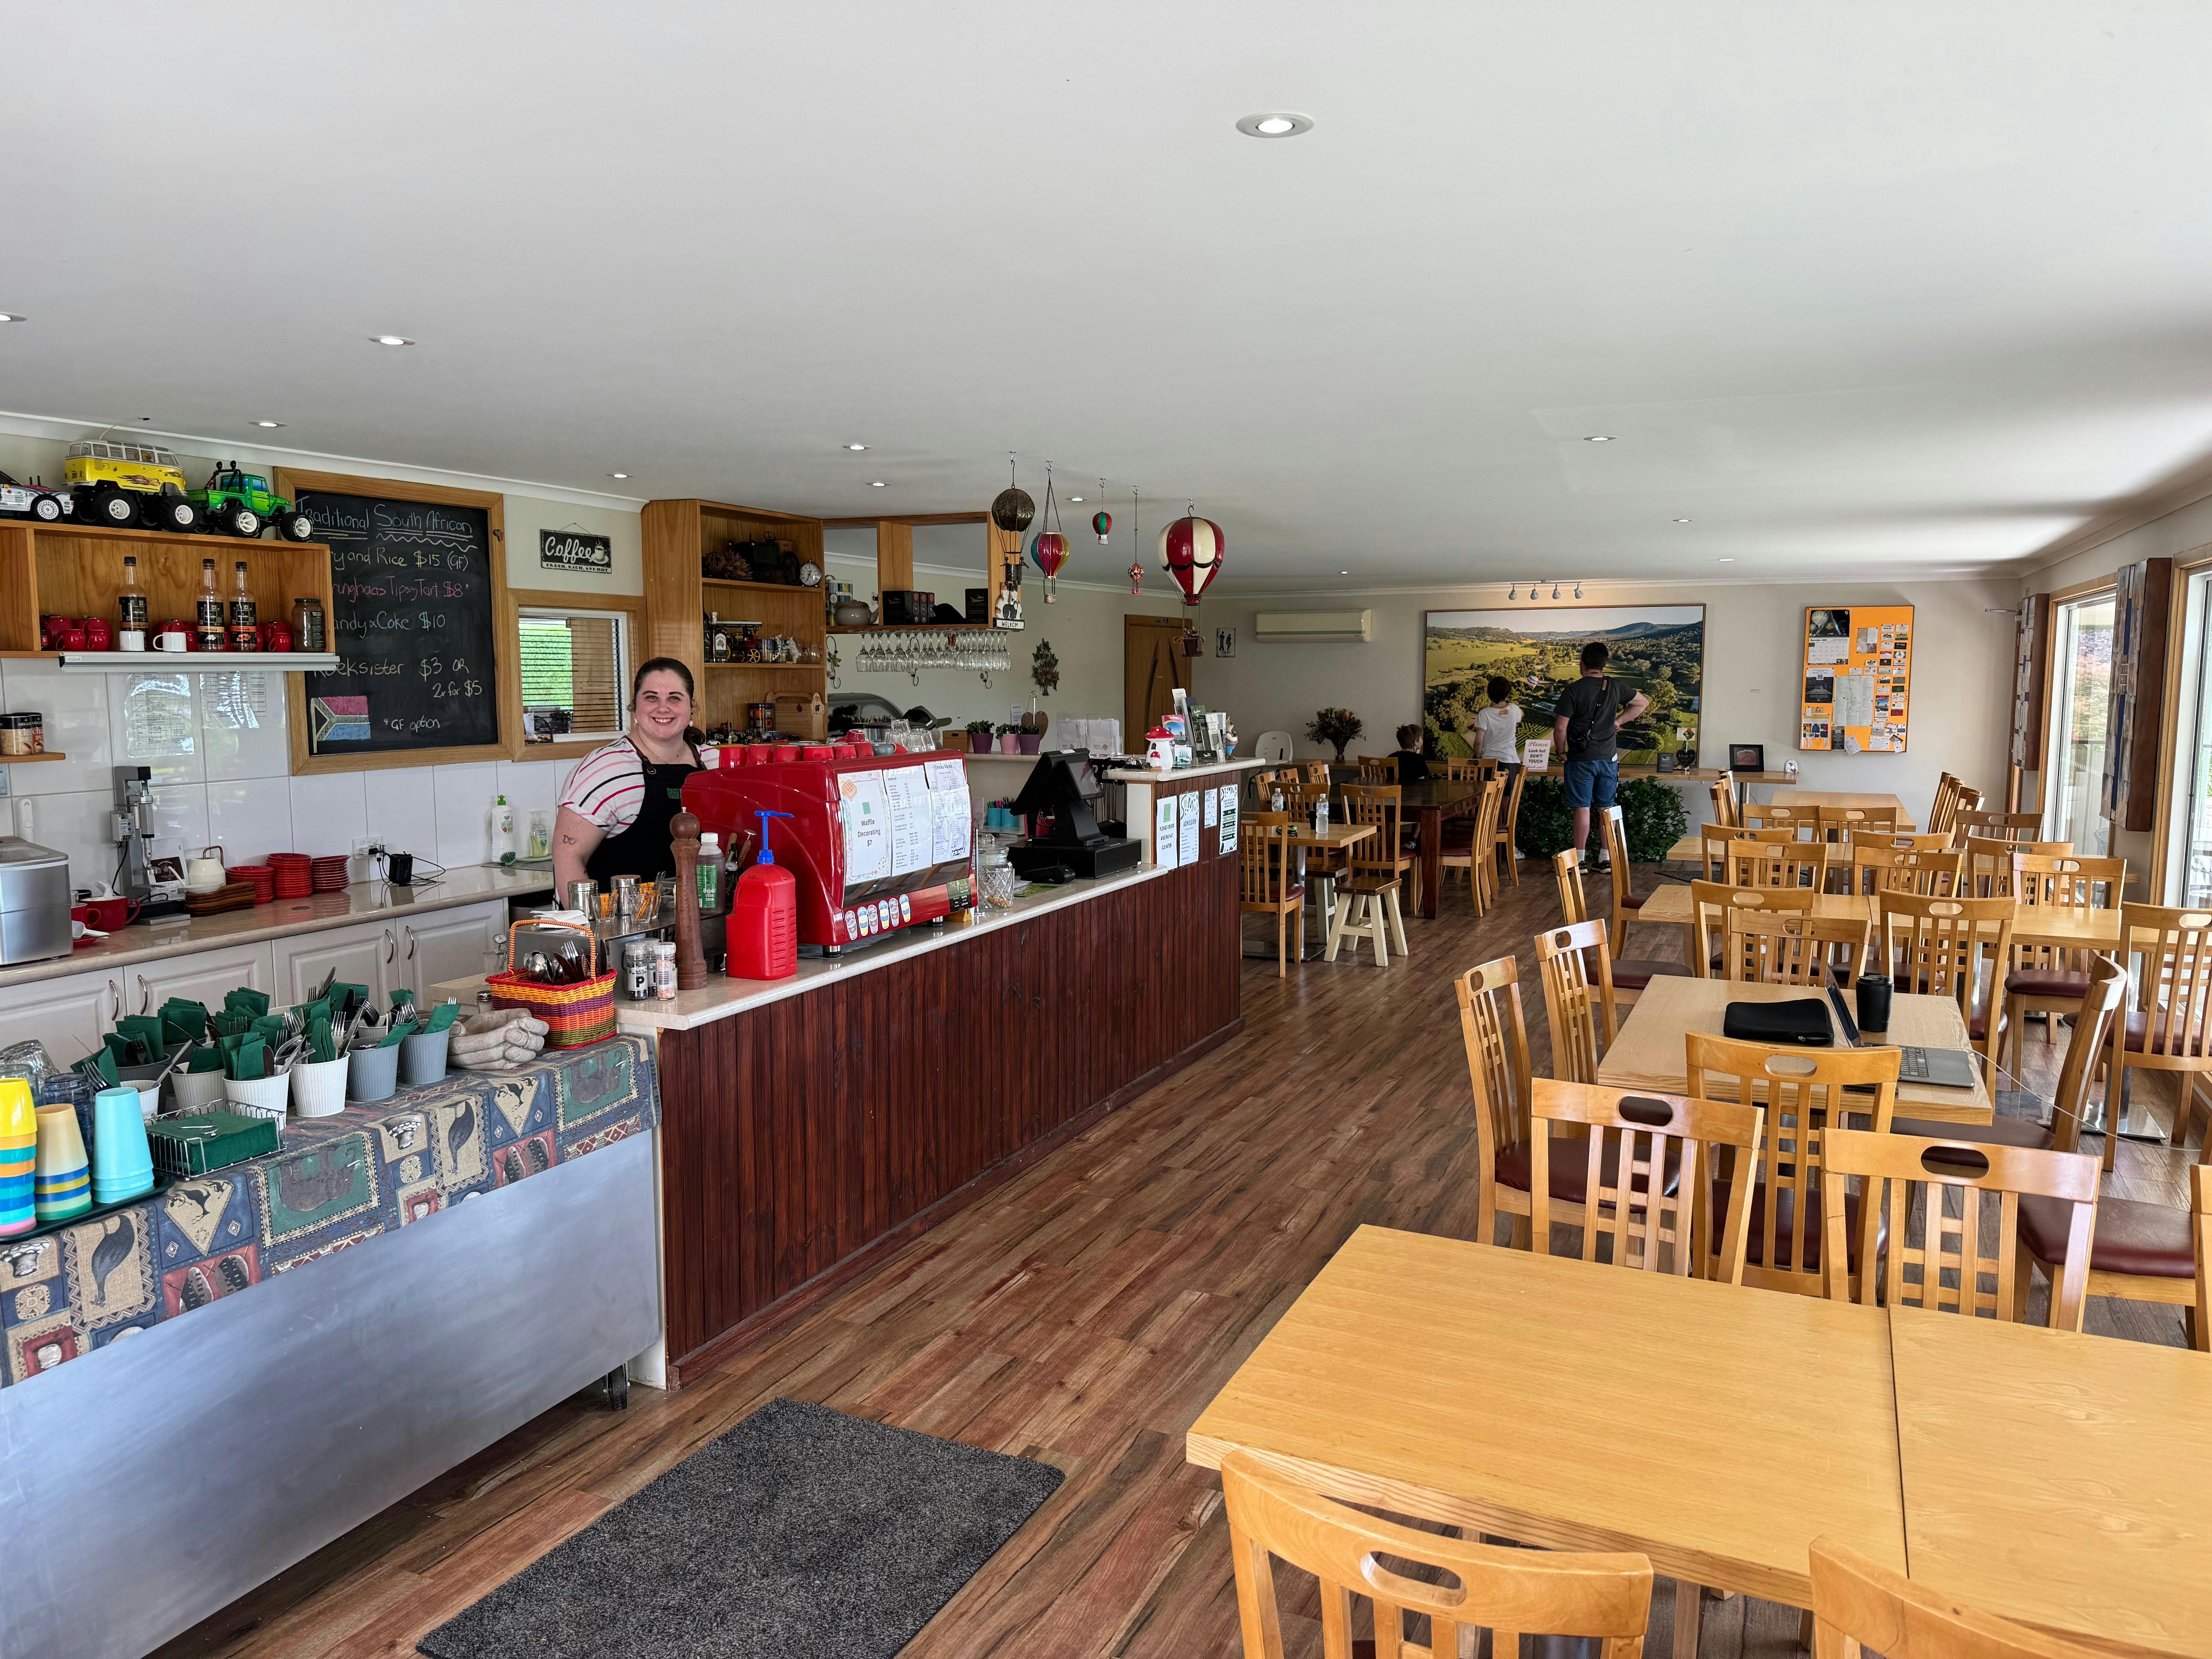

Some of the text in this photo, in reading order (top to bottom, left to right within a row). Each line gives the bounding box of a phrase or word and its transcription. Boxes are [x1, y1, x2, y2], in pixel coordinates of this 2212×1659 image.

[374, 503, 422, 529] South
[426, 510, 472, 533] African
[347, 547, 371, 565] and
[376, 547, 408, 567] Rice
[413, 550, 440, 568] $15
[545, 536, 592, 564] Coffee
[385, 576, 418, 602] Tipsy
[414, 579, 439, 598] Tart
[377, 611, 413, 630] Coke
[419, 610, 445, 632] $10
[419, 656, 442, 682] $3
[448, 681, 461, 696] for
[464, 678, 483, 697] $5
[409, 715, 440, 733] option
[858, 829, 881, 838] Decorating
[635, 976, 645, 988] P
